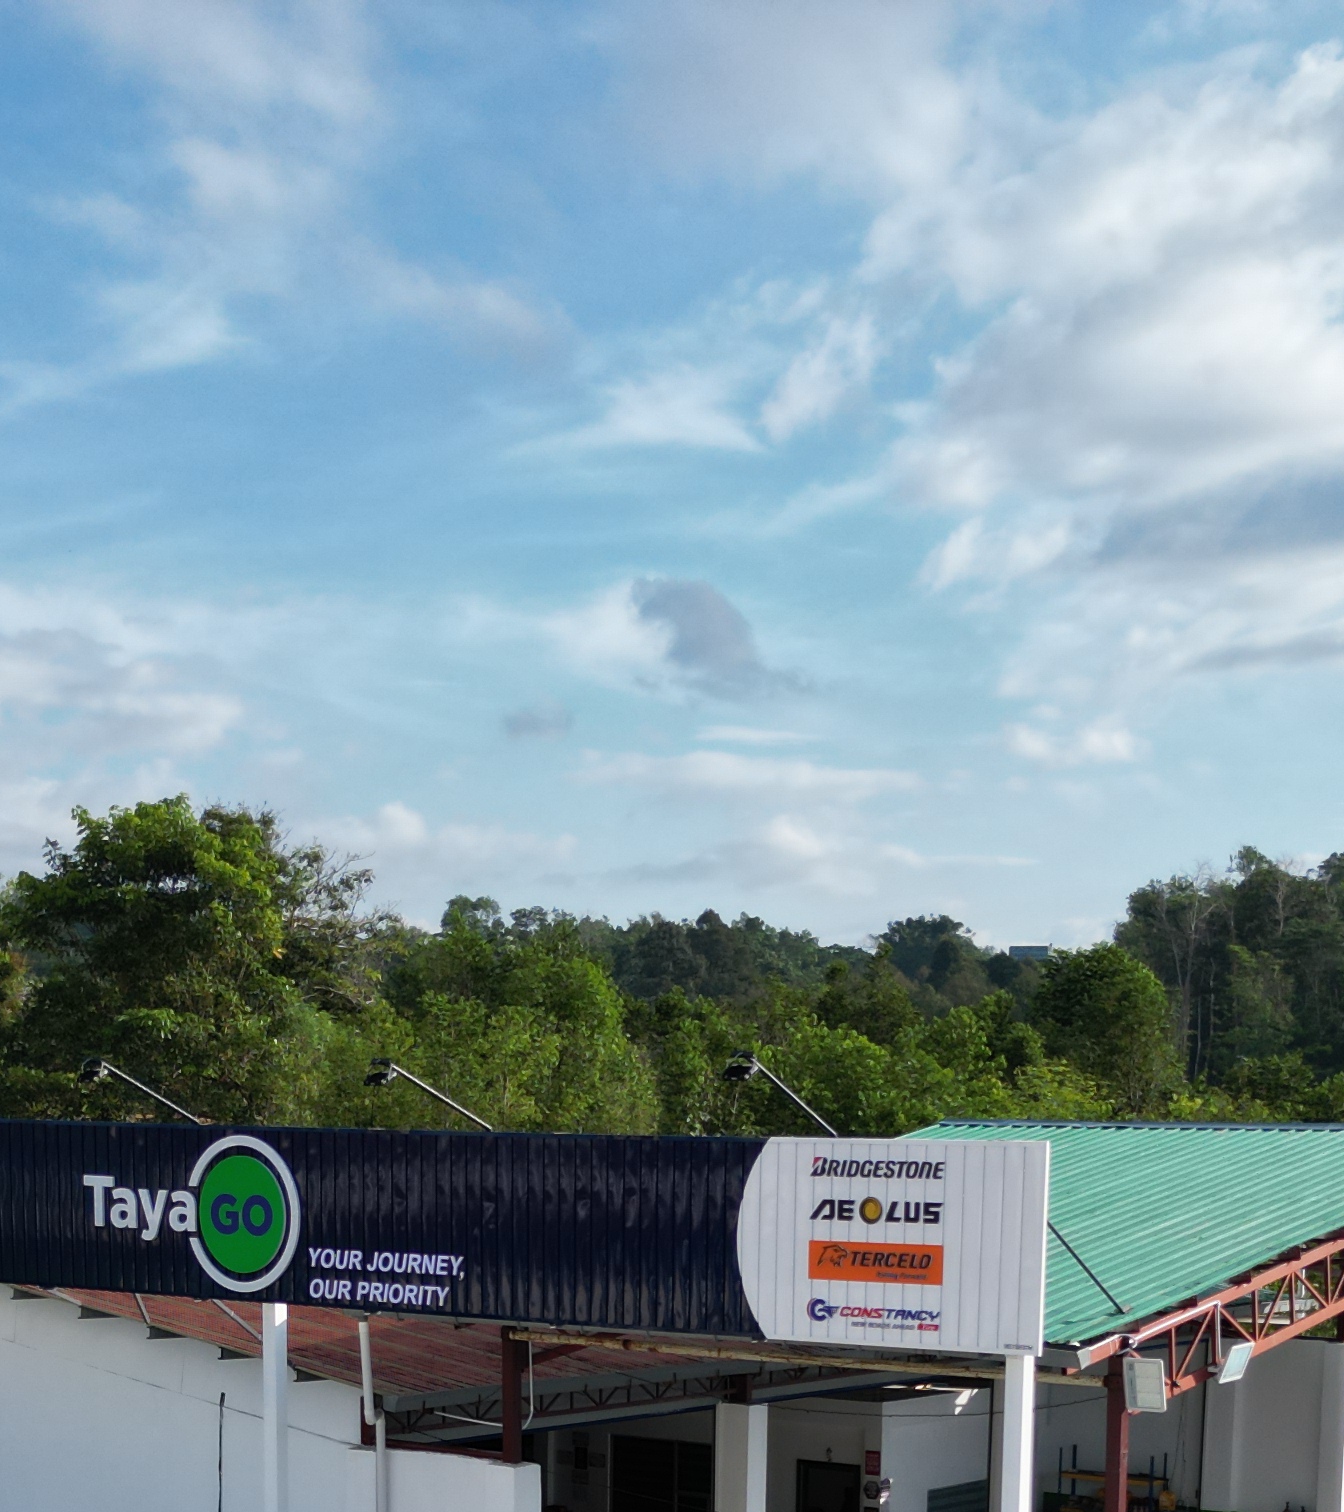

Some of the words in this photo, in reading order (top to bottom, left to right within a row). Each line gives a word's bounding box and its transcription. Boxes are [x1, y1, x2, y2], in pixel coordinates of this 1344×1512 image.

[810, 1157, 945, 1179] BRIDGESTONE
[309, 1247, 362, 1271] YOUR
[367, 1251, 465, 1280] JOURNEY,
[850, 1251, 932, 1269] TERCELO
[310, 1278, 351, 1301] OUR
[356, 1282, 449, 1307] PRIORITY
[840, 1306, 941, 1322] CONSTANCY
